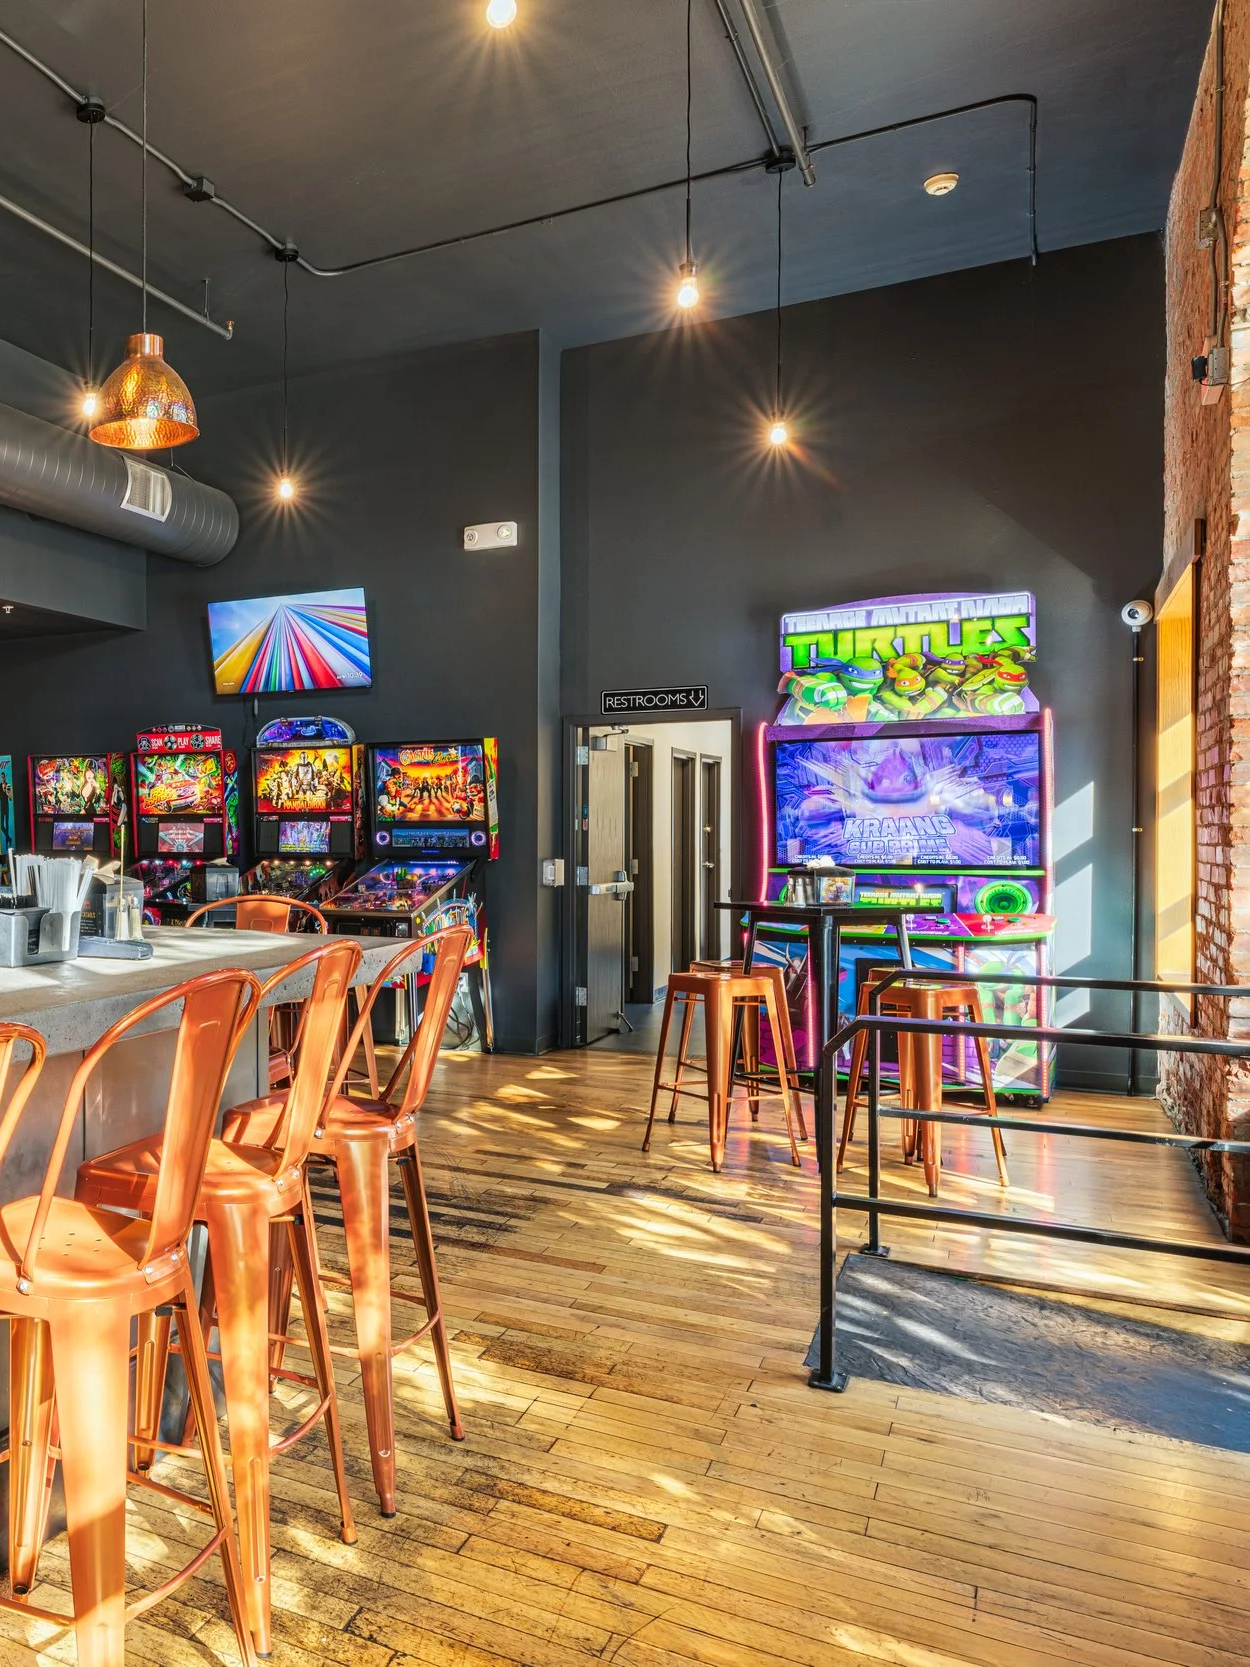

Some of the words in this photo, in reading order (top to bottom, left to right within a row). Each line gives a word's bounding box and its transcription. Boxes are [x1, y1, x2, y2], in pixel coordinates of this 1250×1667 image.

[785, 610, 867, 633] TEENAGE
[870, 602, 960, 626] MUTANT
[961, 595, 1030, 618] NINJA
[783, 614, 1031, 669] TURTLES
[606, 693, 687, 708] RESTROOMS
[151, 738, 163, 748] SCAN
[178, 737, 190, 746] PLAY
[205, 736, 221, 745] SHARE
[842, 815, 956, 840] KRAANG
[848, 839, 886, 855] SUB
[887, 837, 952, 855] PRIME
